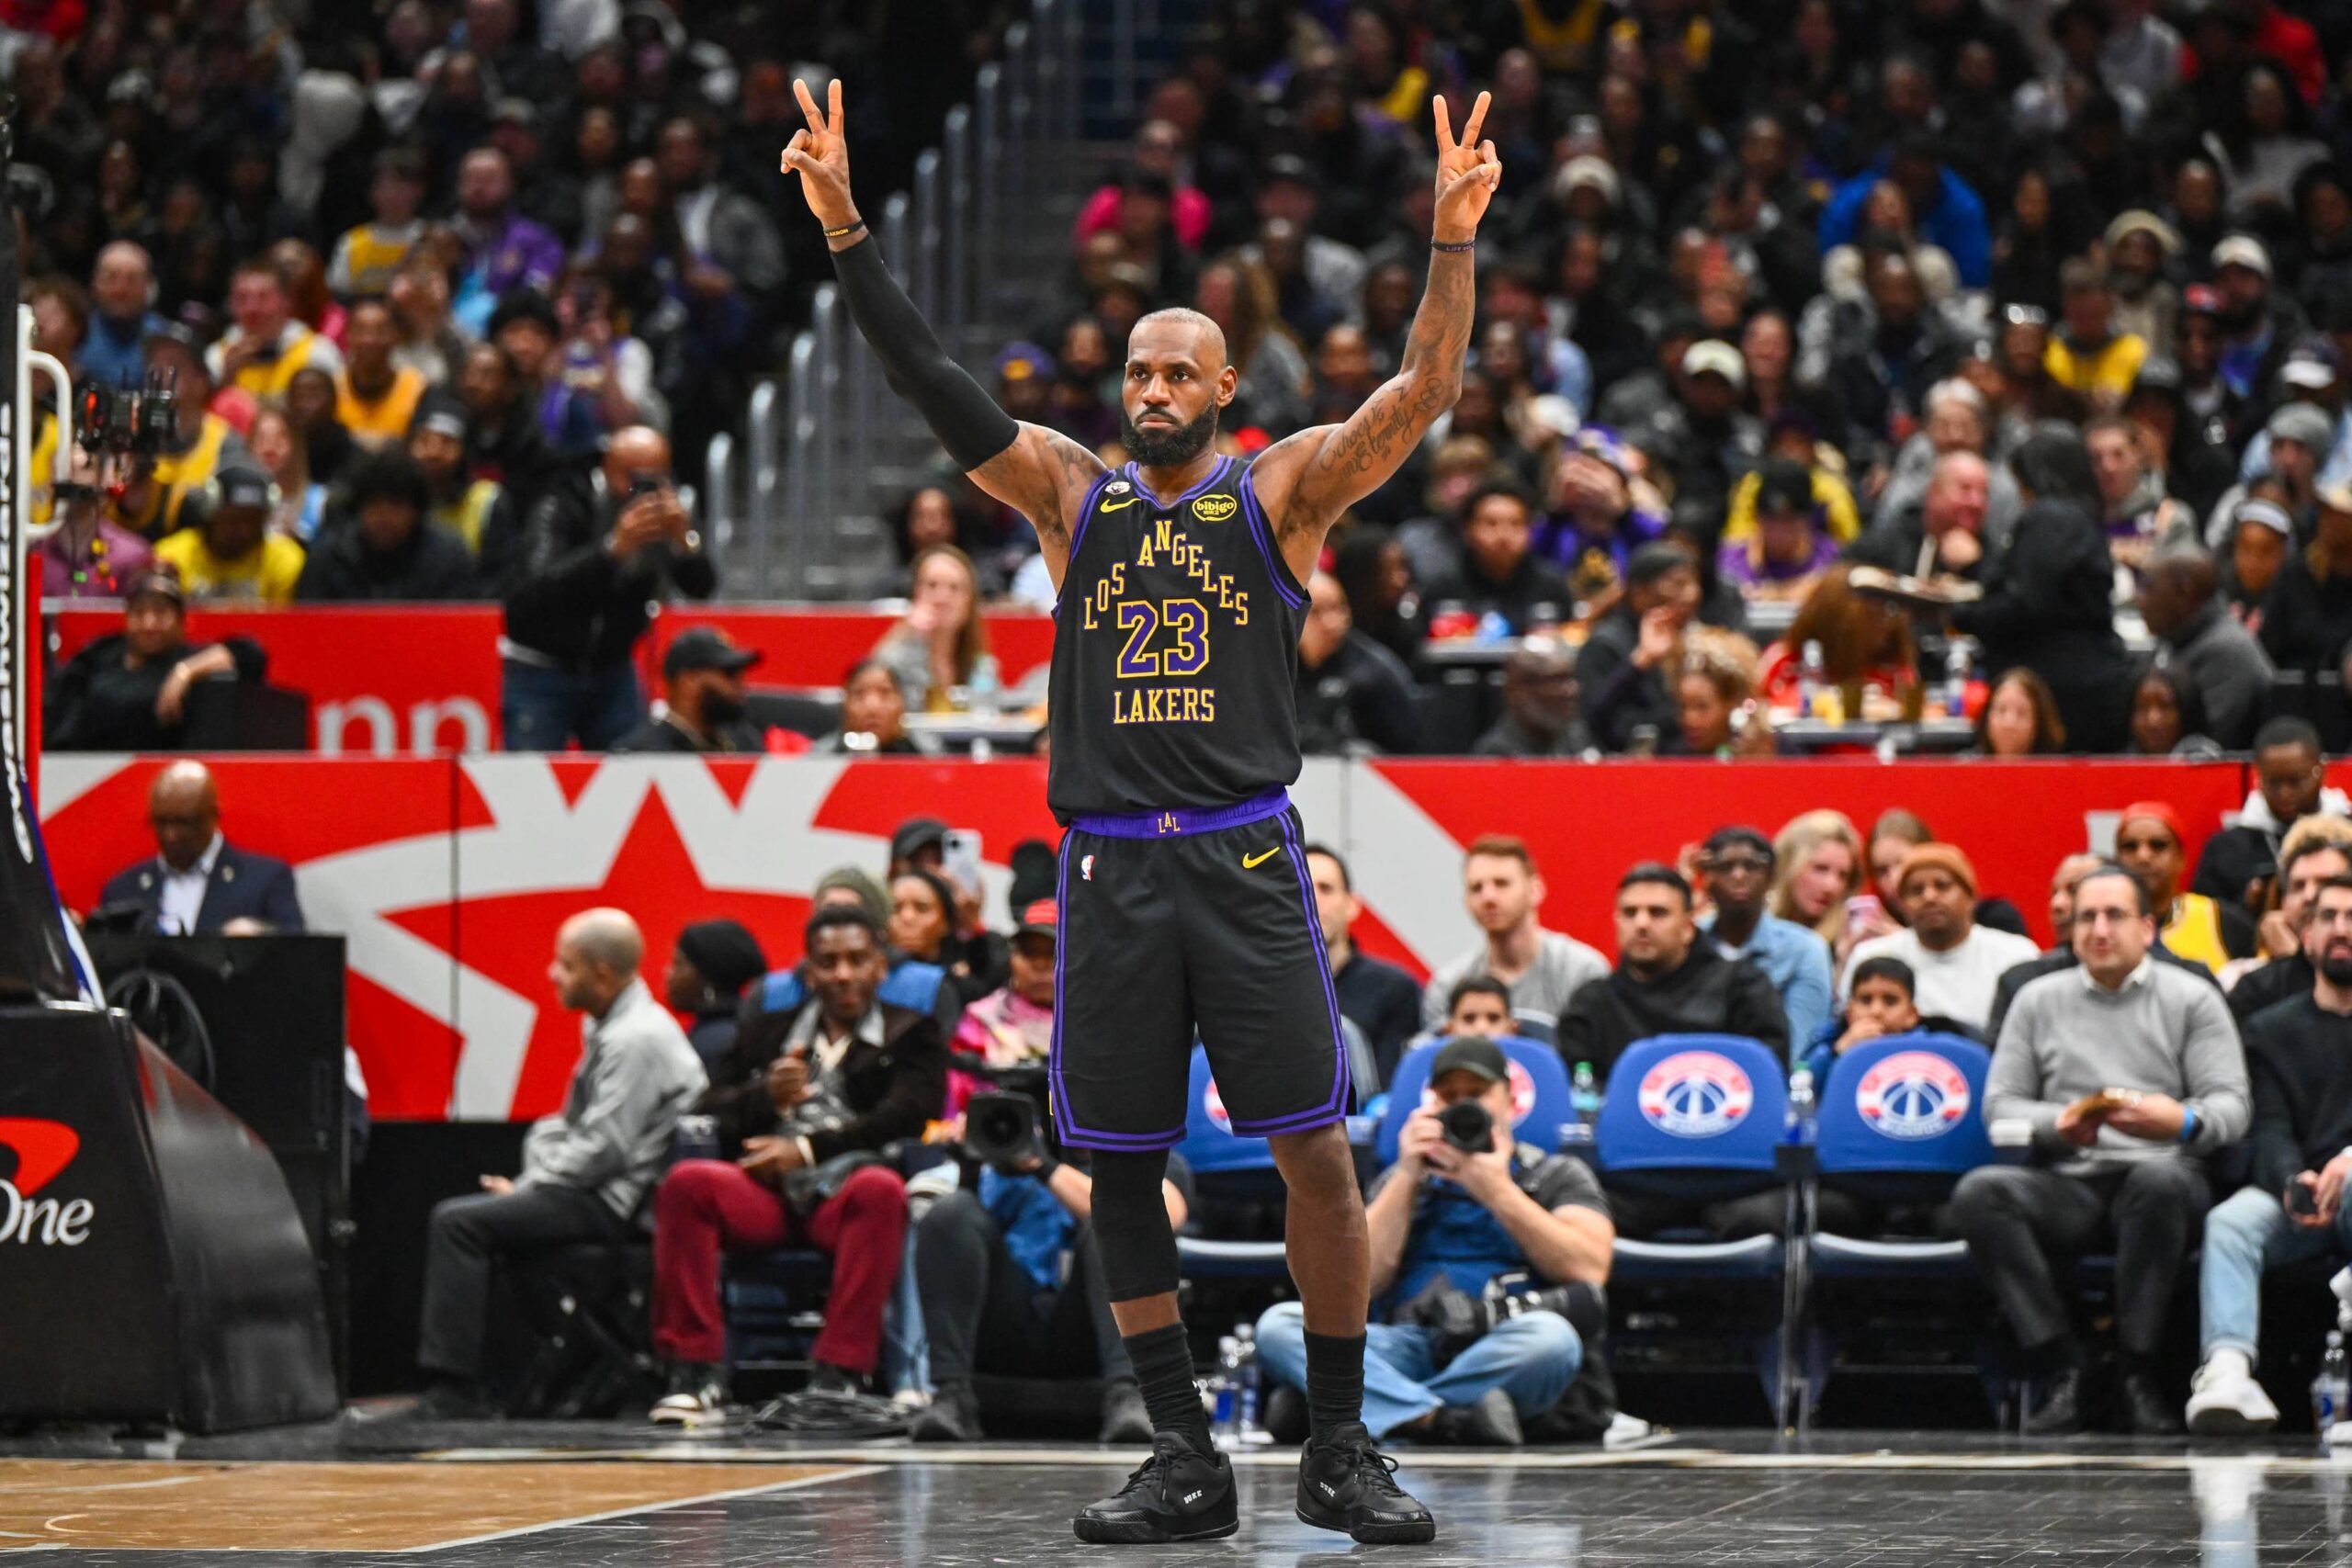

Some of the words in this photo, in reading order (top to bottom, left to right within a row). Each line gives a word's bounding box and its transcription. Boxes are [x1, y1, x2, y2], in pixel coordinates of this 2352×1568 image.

[1196, 501, 1234, 513] bibigo
[1084, 561, 1125, 630] LOS
[1136, 520, 1249, 625] ANGELES
[1116, 598, 1209, 678] 23
[1113, 687, 1215, 724] LAKERS
[1158, 812, 1181, 833] LAL
[1183, 1489, 1203, 1504] DUKE
